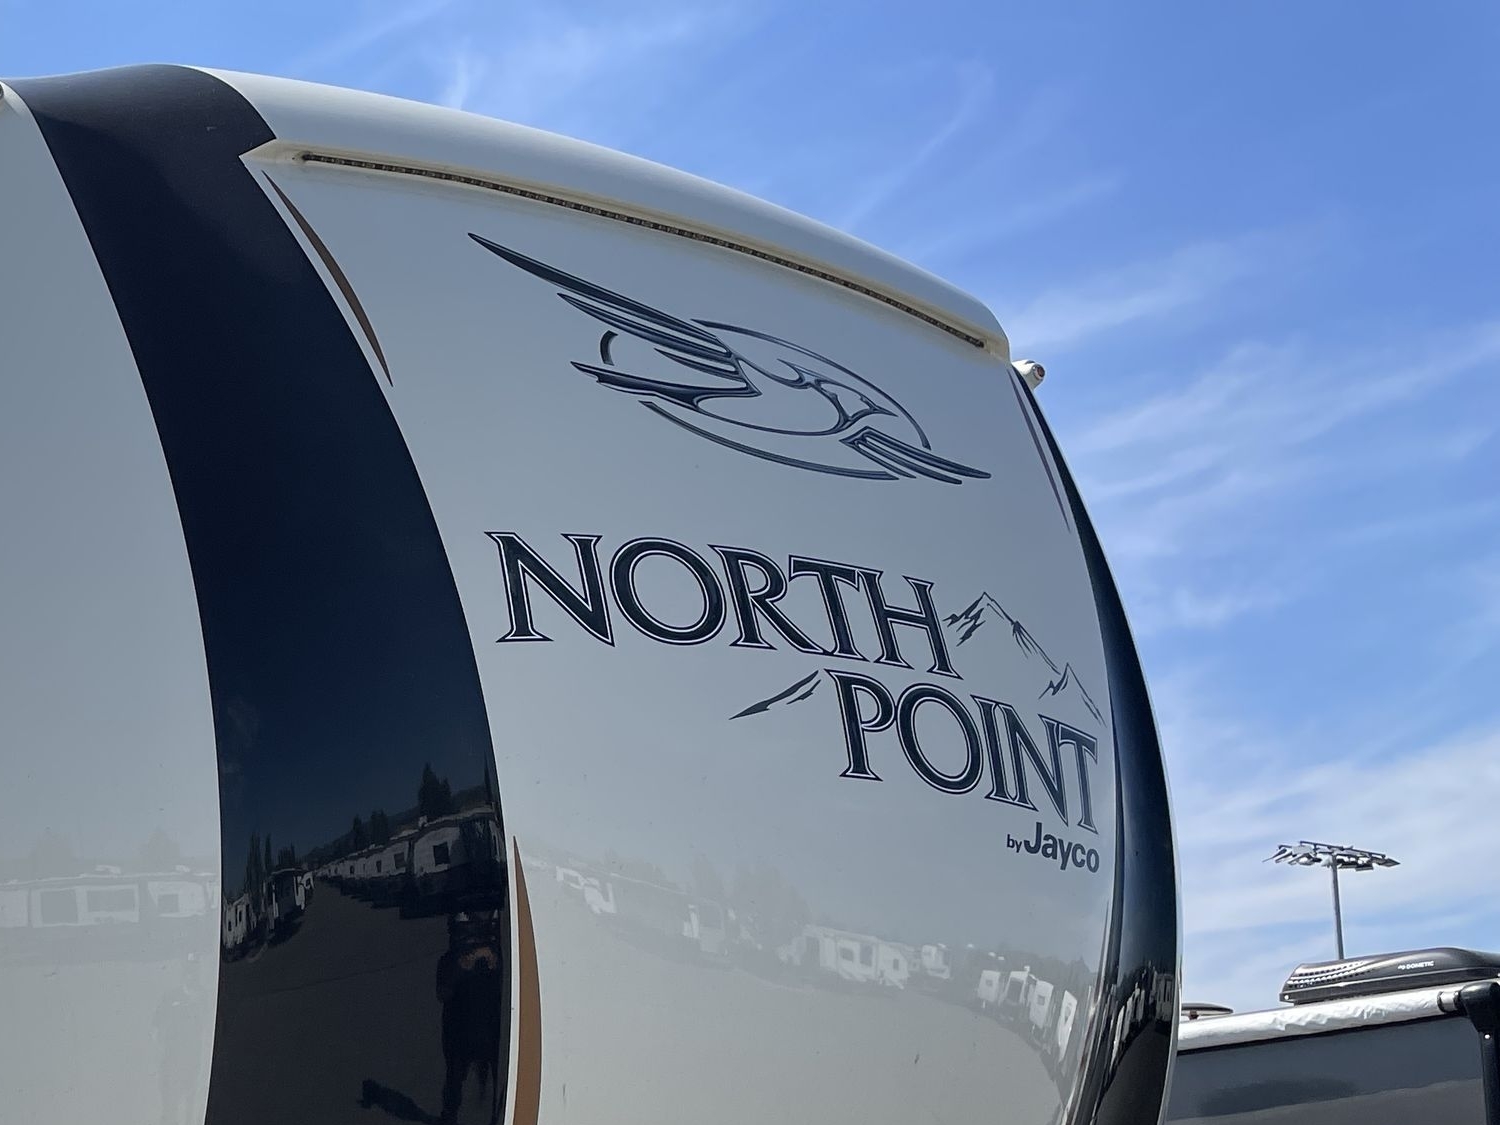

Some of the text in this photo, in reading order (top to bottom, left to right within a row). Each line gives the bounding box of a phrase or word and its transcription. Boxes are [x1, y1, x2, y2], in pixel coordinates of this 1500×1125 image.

[484, 530, 963, 680] NORTH
[824, 668, 1099, 834] POINT
[1006, 821, 1100, 874] by Jayco
